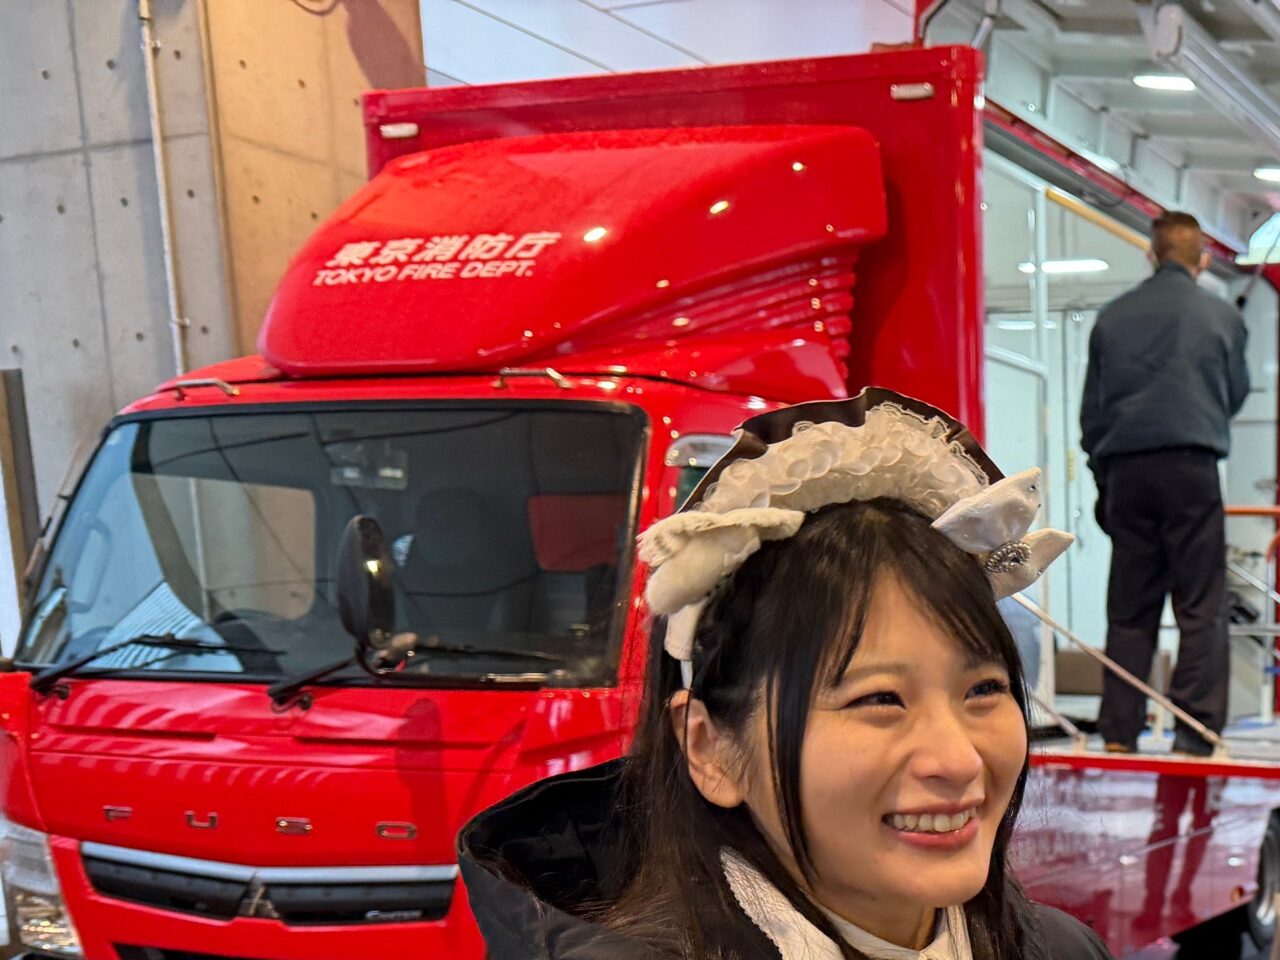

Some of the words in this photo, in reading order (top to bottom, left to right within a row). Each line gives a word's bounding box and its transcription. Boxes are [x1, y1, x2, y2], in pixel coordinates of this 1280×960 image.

[326, 231, 562, 267] 東京消防庁
[312, 265, 397, 286] TOKYO
[398, 262, 460, 281] FIRE
[460, 260, 536, 279] DEPT.
[103, 804, 417, 840] FUSO
